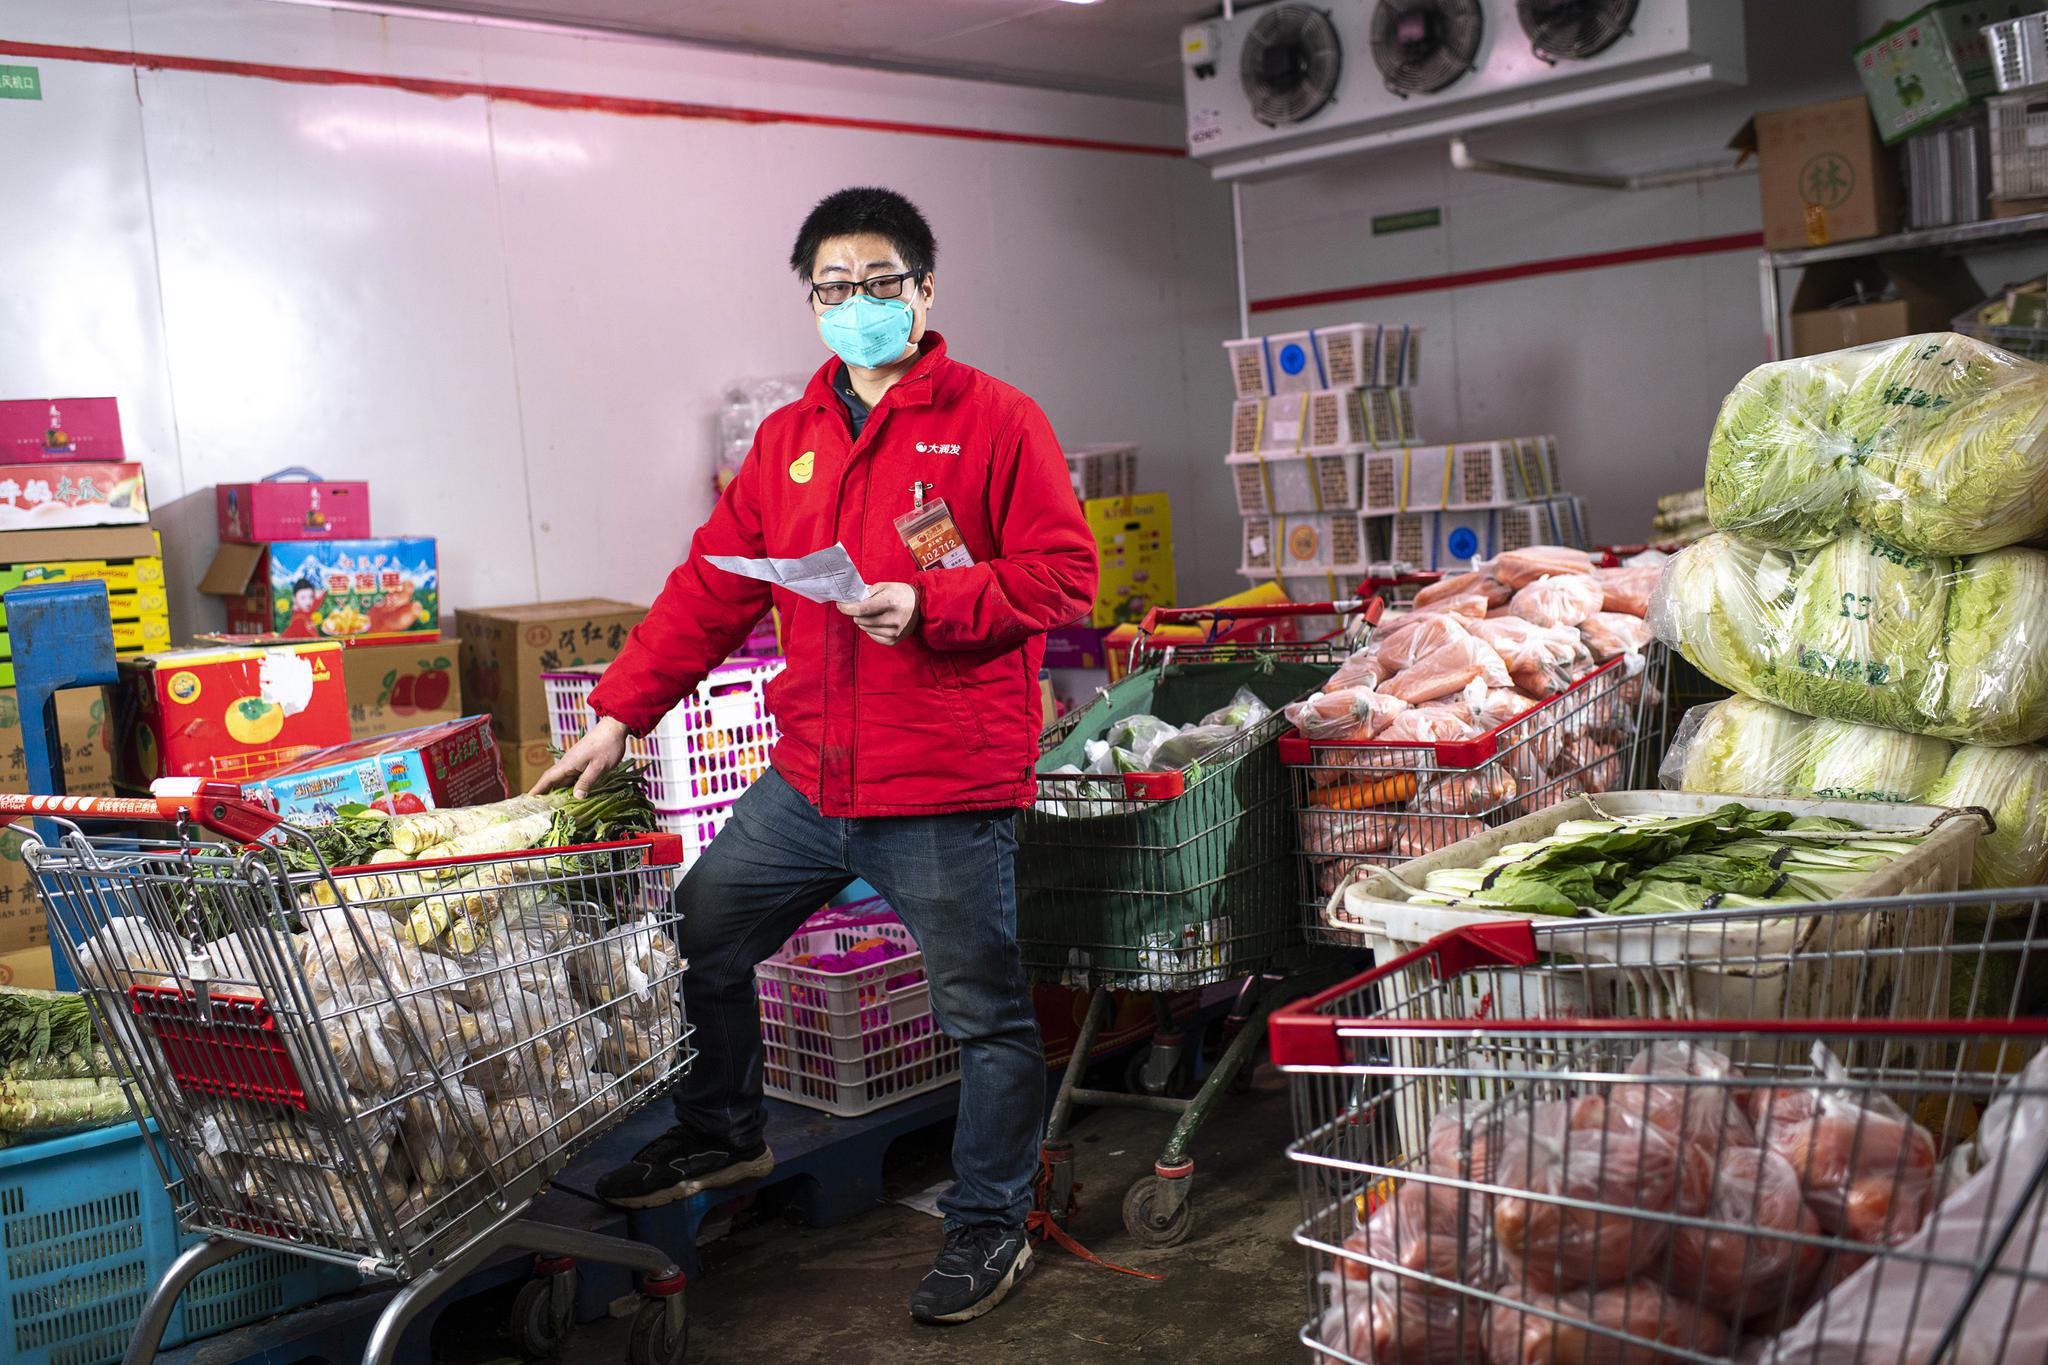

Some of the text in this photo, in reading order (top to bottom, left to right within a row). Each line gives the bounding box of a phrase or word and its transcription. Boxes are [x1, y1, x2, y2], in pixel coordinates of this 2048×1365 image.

[0, 75, 33, 89] 风机口
[927, 443, 961, 456] 大润发
[0, 476, 104, 506] 牛奶木瓜
